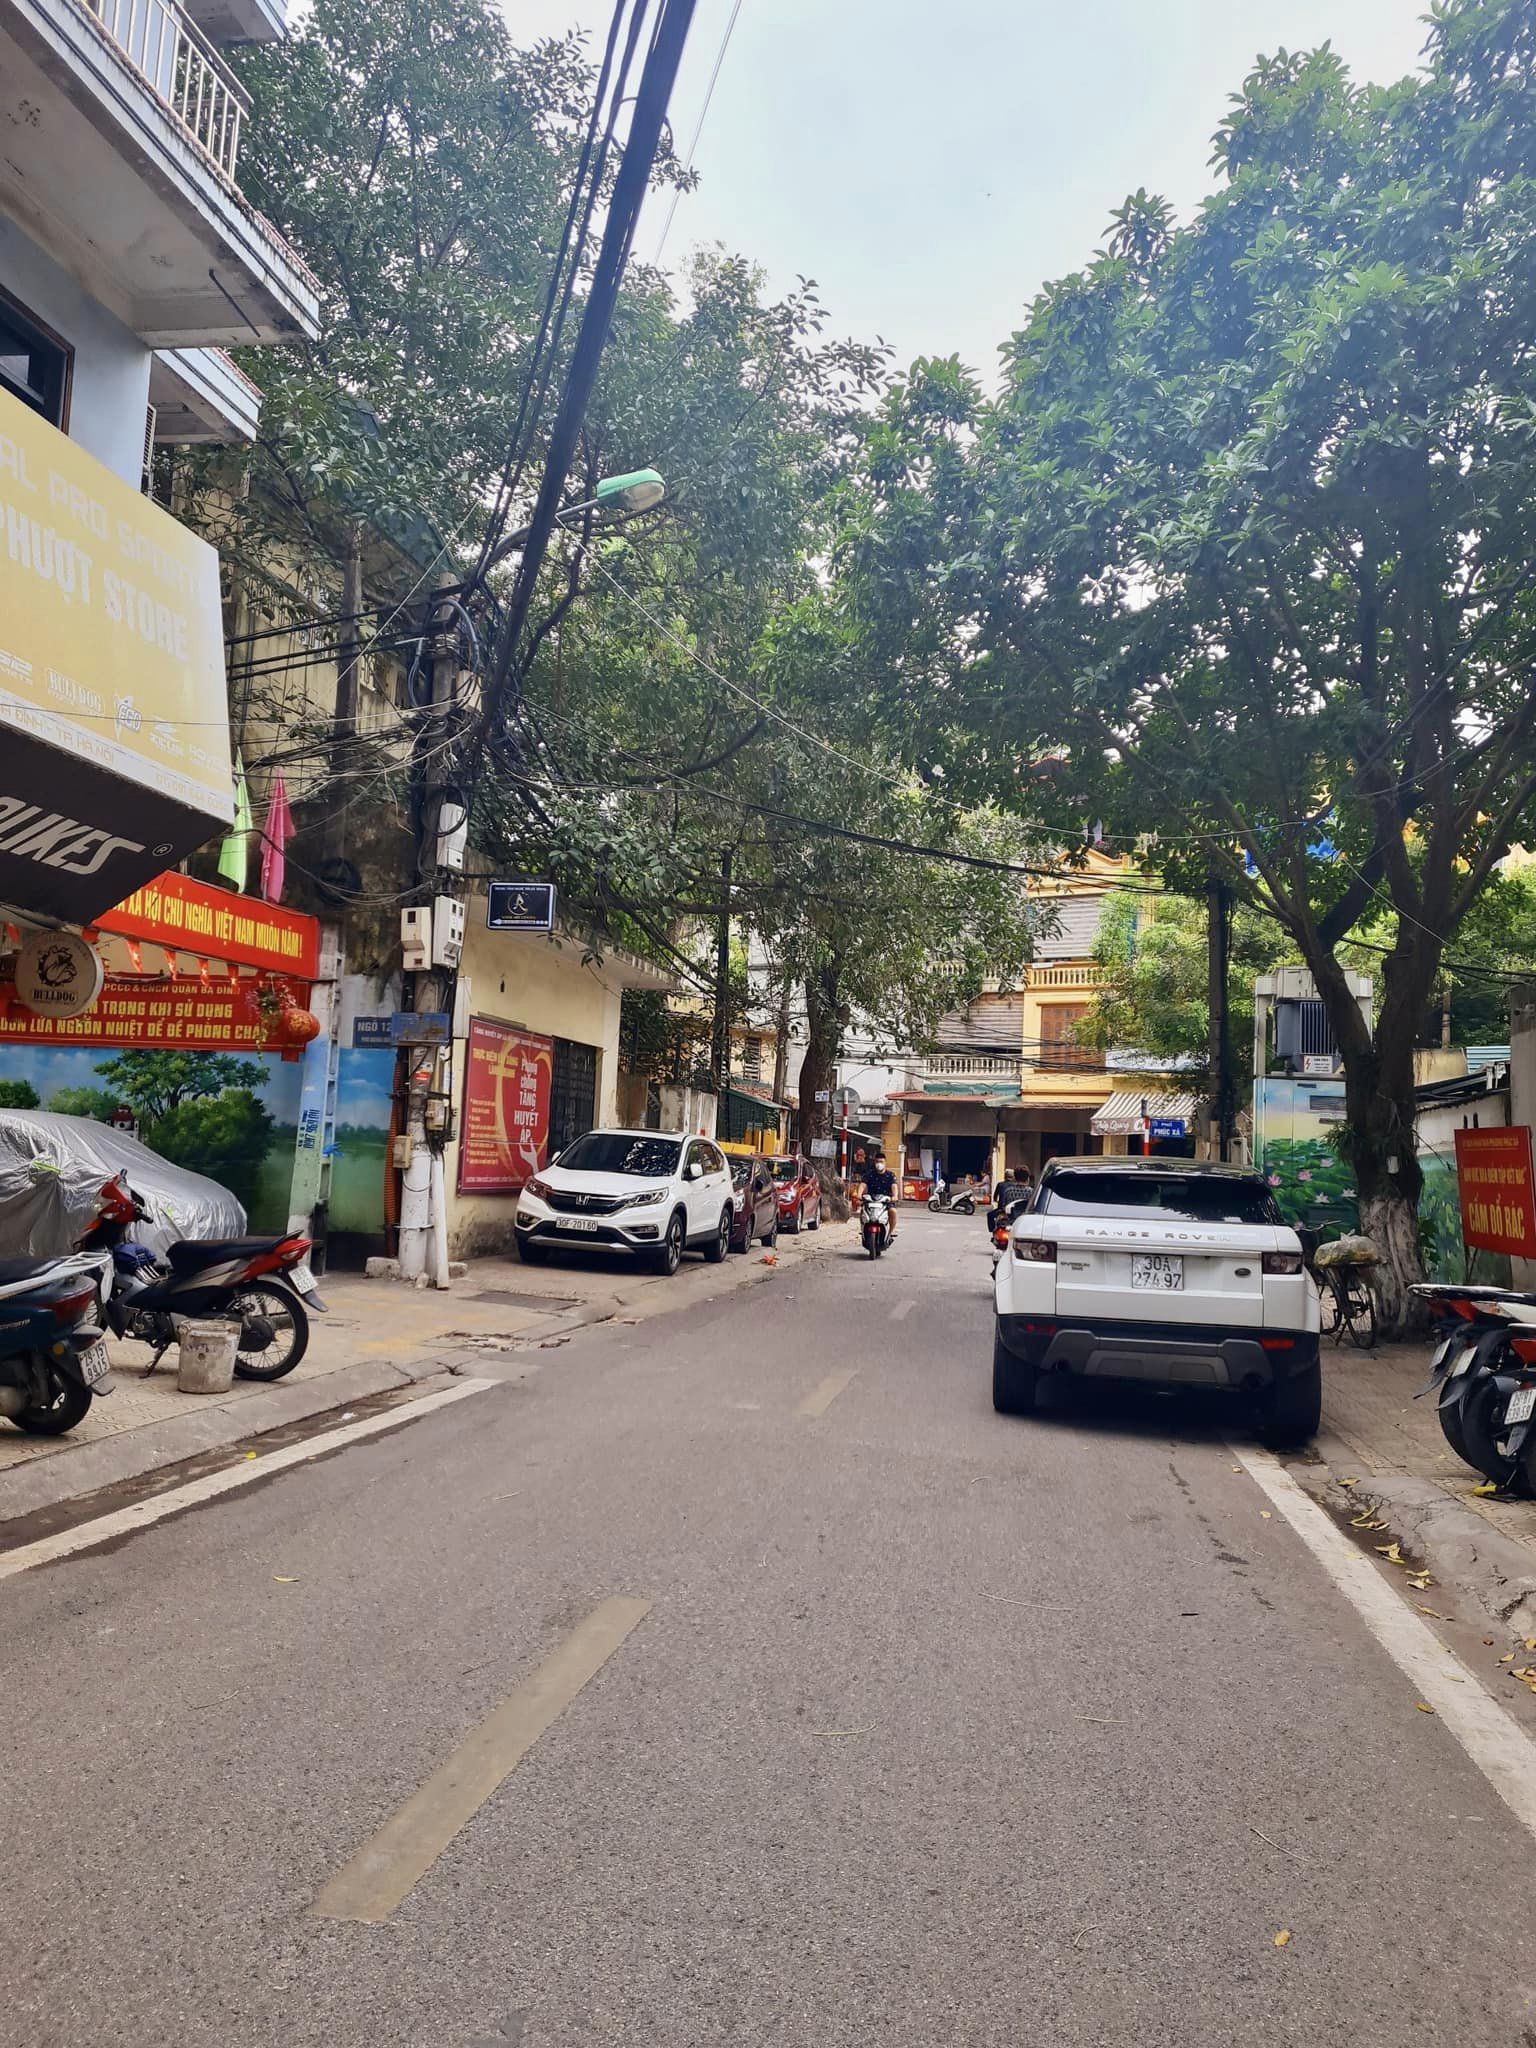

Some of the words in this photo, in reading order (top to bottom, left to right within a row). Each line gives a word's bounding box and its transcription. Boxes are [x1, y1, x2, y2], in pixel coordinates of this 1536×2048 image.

[49, 467, 108, 541] PRO
[103, 569, 190, 663] STORE
[144, 886, 161, 927] HỘI
[164, 888, 183, 928] CHỦ
[185, 901, 213, 938] NGHĨA
[215, 907, 234, 945] VIỆT
[235, 916, 254, 945] NAM
[256, 920, 279, 953] MUÔN
[281, 926, 303, 959] NĂM!
[33, 989, 76, 1001] BULLDOG
[104, 983, 130, 992] PCCC
[102, 1000, 145, 1018] TRỌNG
[150, 1001, 171, 1016] KHI
[197, 1003, 232, 1021] DỤNG
[105, 1019, 143, 1039] NHIỆT
[186, 1018, 230, 1039] PHÒNG
[514, 1107, 539, 1126] HUYẾT
[1154, 1126, 1170, 1136] PHÚC
[1468, 1192, 1489, 1234] CẤM
[1504, 1200, 1525, 1240] RÁC
[1085, 1229, 1149, 1237] RANGE
[1165, 1232, 1231, 1241] ROVER
[1144, 1255, 1171, 1272] 30A
